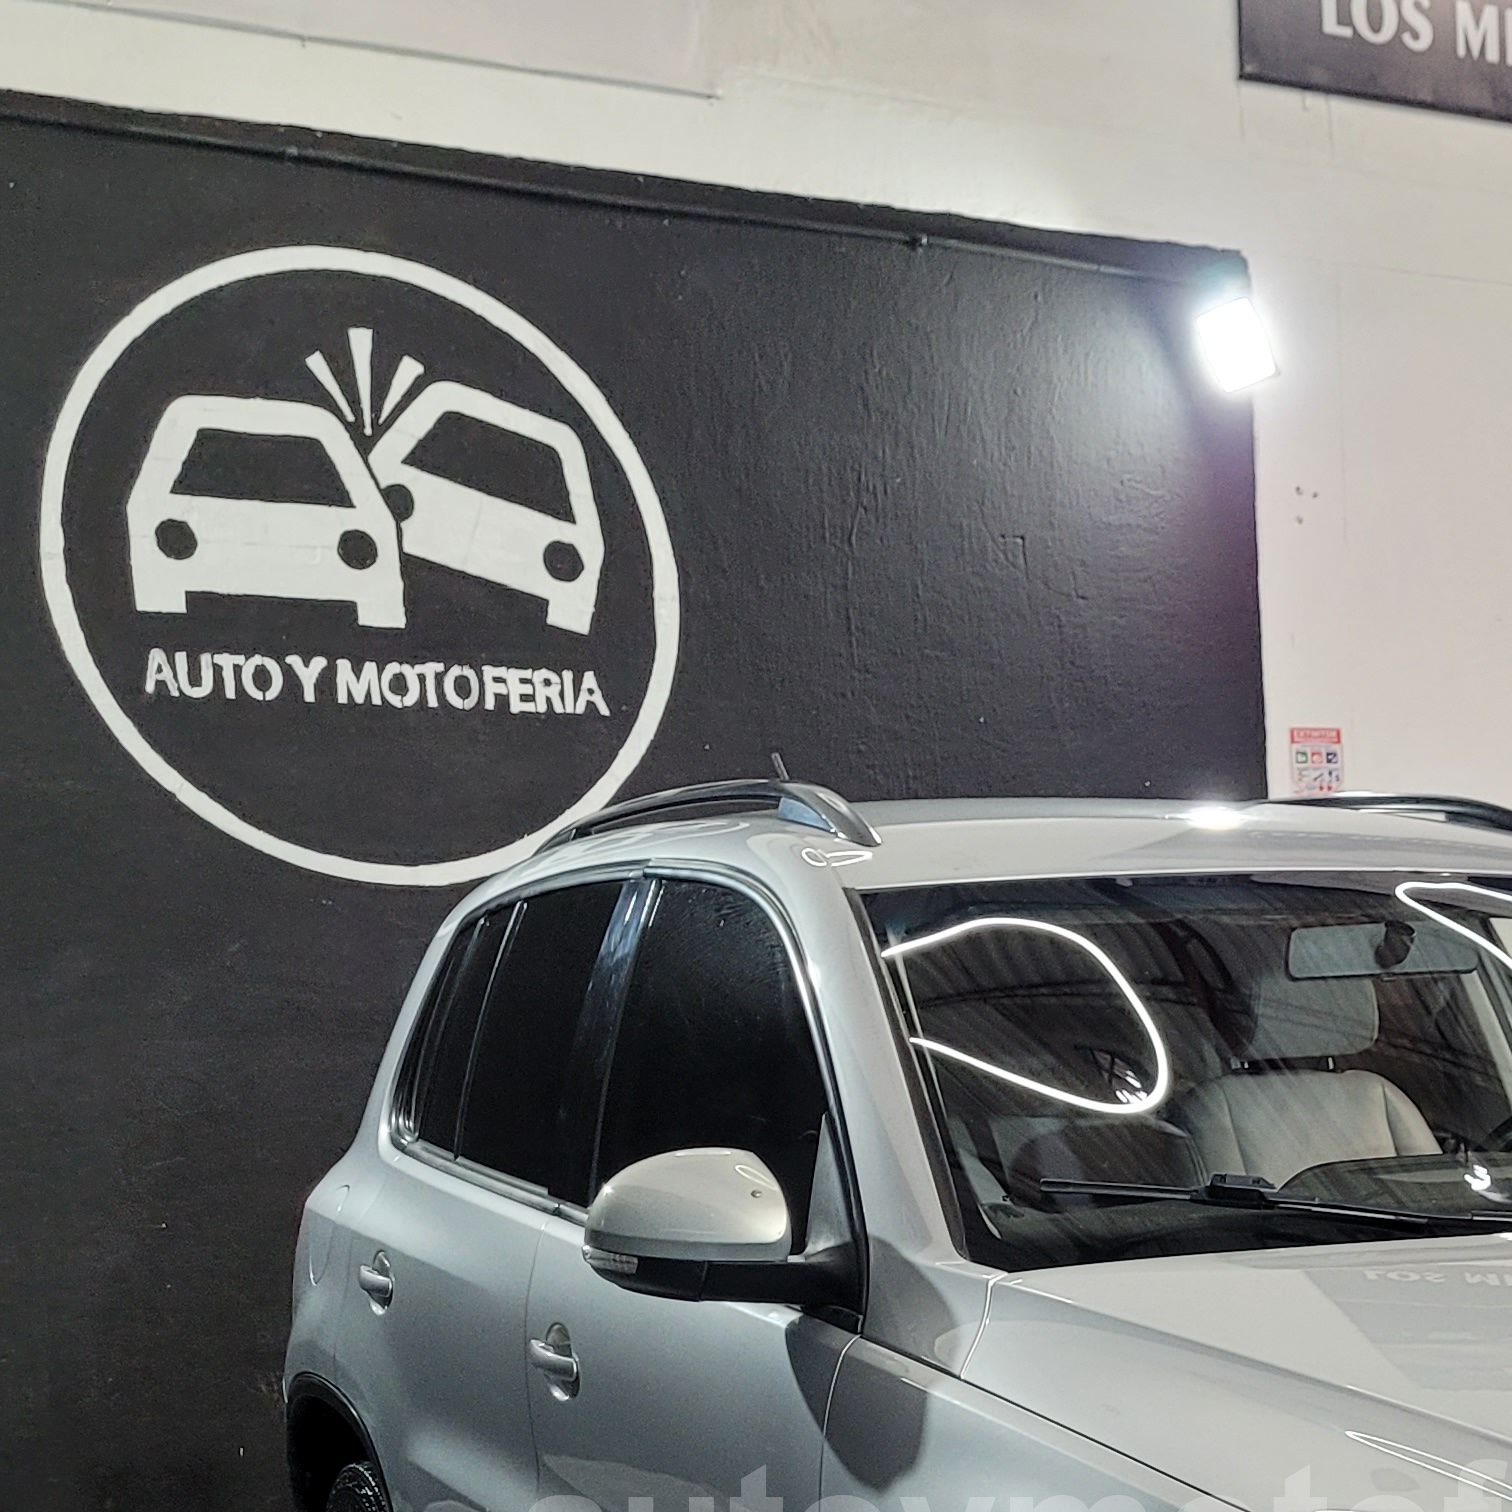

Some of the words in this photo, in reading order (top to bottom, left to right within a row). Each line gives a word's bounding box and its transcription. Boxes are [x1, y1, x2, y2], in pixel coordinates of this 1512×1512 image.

[1319, 0, 1435, 52] LOS
[144, 647, 284, 702] AUTO
[285, 656, 327, 703] Y
[336, 659, 611, 718] MOTOFERIA
